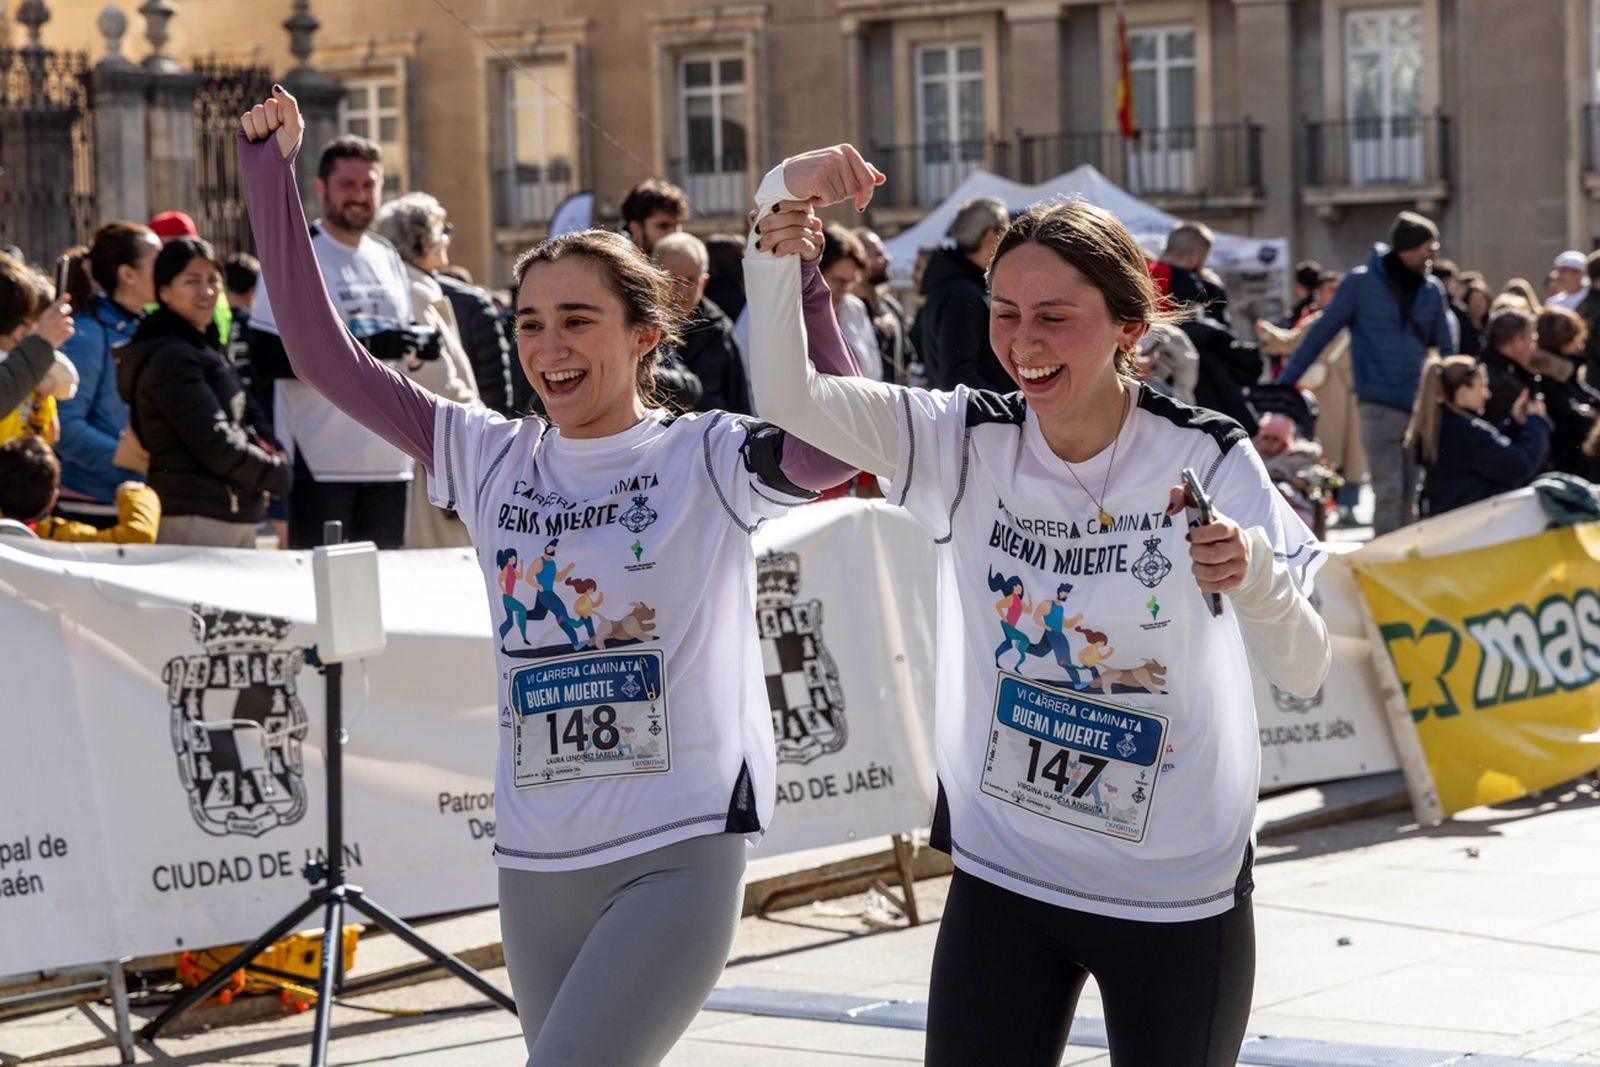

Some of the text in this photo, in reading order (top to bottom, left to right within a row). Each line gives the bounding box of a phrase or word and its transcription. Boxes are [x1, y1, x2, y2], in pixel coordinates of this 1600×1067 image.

[989, 520, 1128, 576] BUENA MUERTE
[1463, 588, 1600, 709] mas
[526, 674, 535, 685] VI
[536, 665, 581, 682] CARRERA
[583, 660, 641, 676] CAMINATA
[526, 680, 615, 709] BUENA MUERTE
[1017, 688, 1142, 733] VI CARRERA CAMINATA
[546, 705, 620, 755] 148
[1012, 704, 1112, 751] BUENA MUERTE
[776, 761, 895, 805] AD DE JAÉN
[1027, 738, 1110, 799] 147
[438, 791, 495, 814] Patro
[467, 818, 497, 840] De
[0, 833, 68, 870] pal de
[153, 856, 254, 893] CIUDAD
[258, 851, 294, 879] DE
[0, 868, 44, 898] aén
